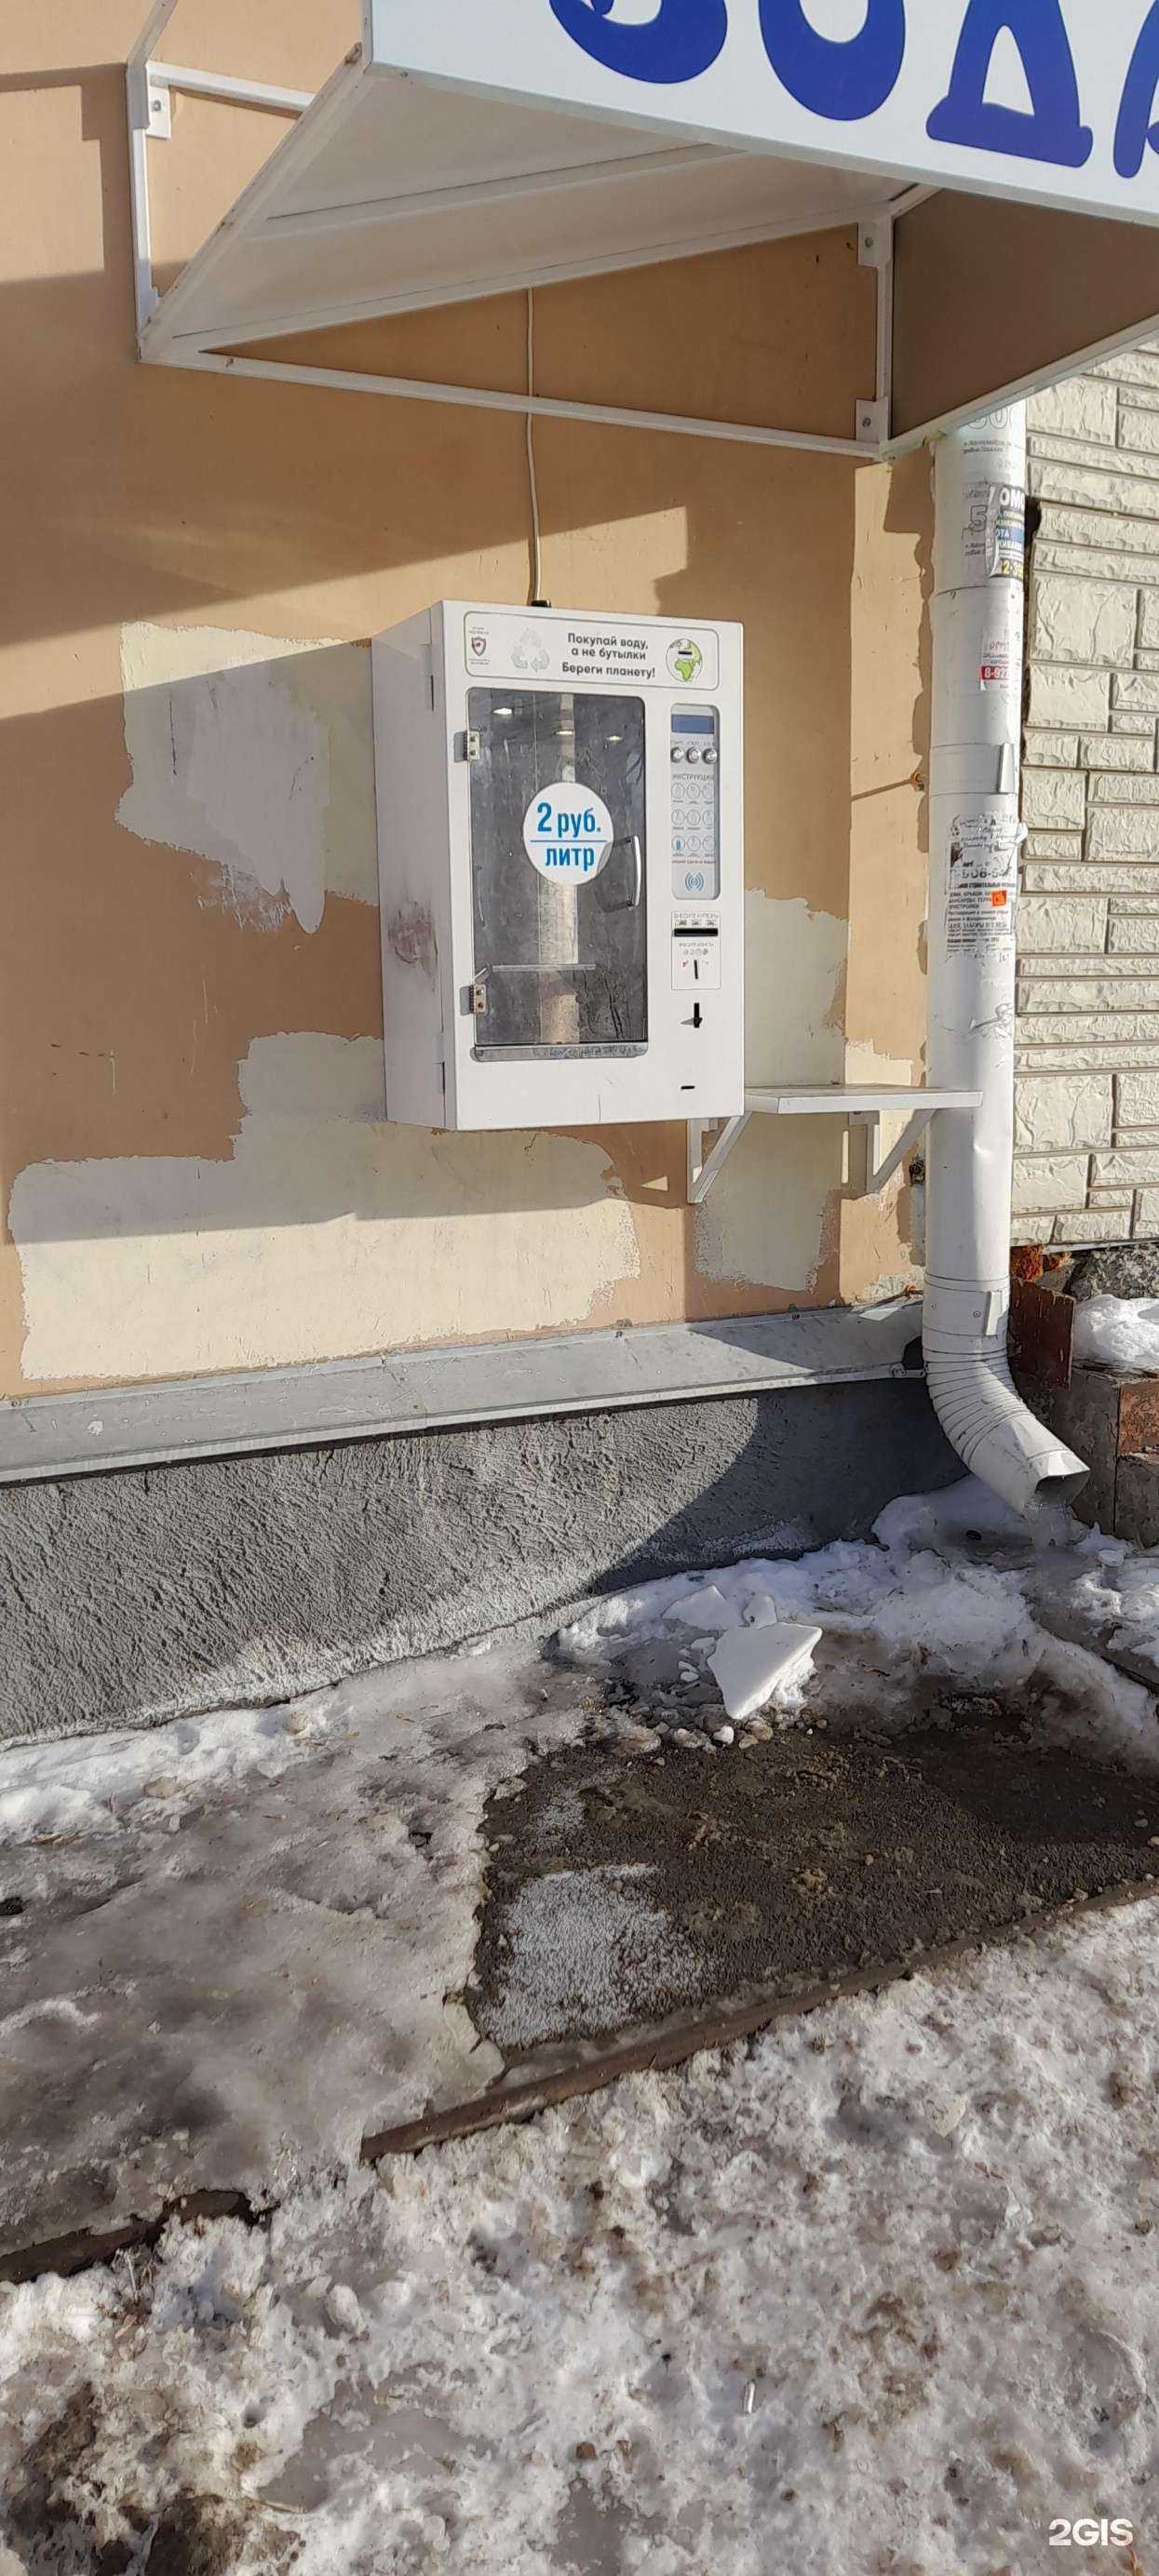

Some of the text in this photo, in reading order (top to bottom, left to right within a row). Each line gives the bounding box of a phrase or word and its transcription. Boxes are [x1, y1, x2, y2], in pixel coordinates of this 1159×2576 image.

[568, 633, 649, 651] Покупай воду,
[582, 649, 596, 657] не
[599, 647, 646, 660] бутылки
[561, 662, 655, 679] Береги планету!
[537, 802, 601, 838] 2 руб.
[546, 848, 595, 872] литр
